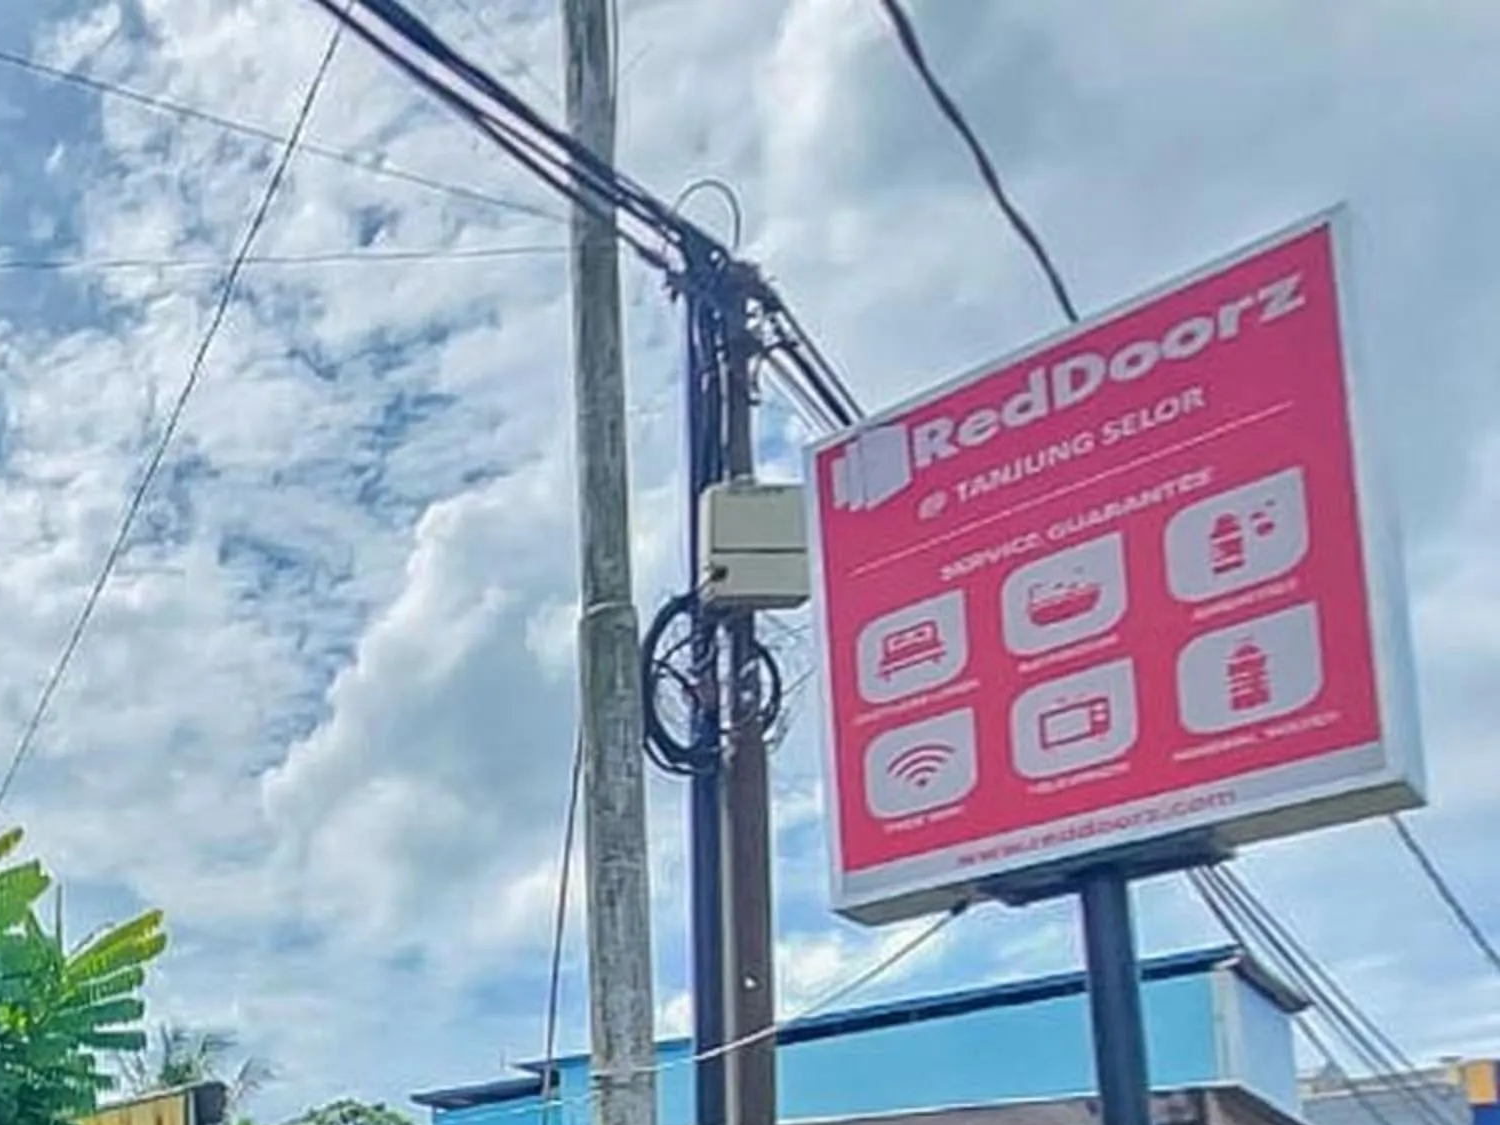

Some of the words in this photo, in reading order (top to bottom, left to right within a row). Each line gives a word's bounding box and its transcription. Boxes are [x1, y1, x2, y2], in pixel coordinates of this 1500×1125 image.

[911, 272, 1306, 467] RedDoorz
[956, 431, 1096, 505] TANJUNG
[1100, 386, 1206, 446] SELOR
